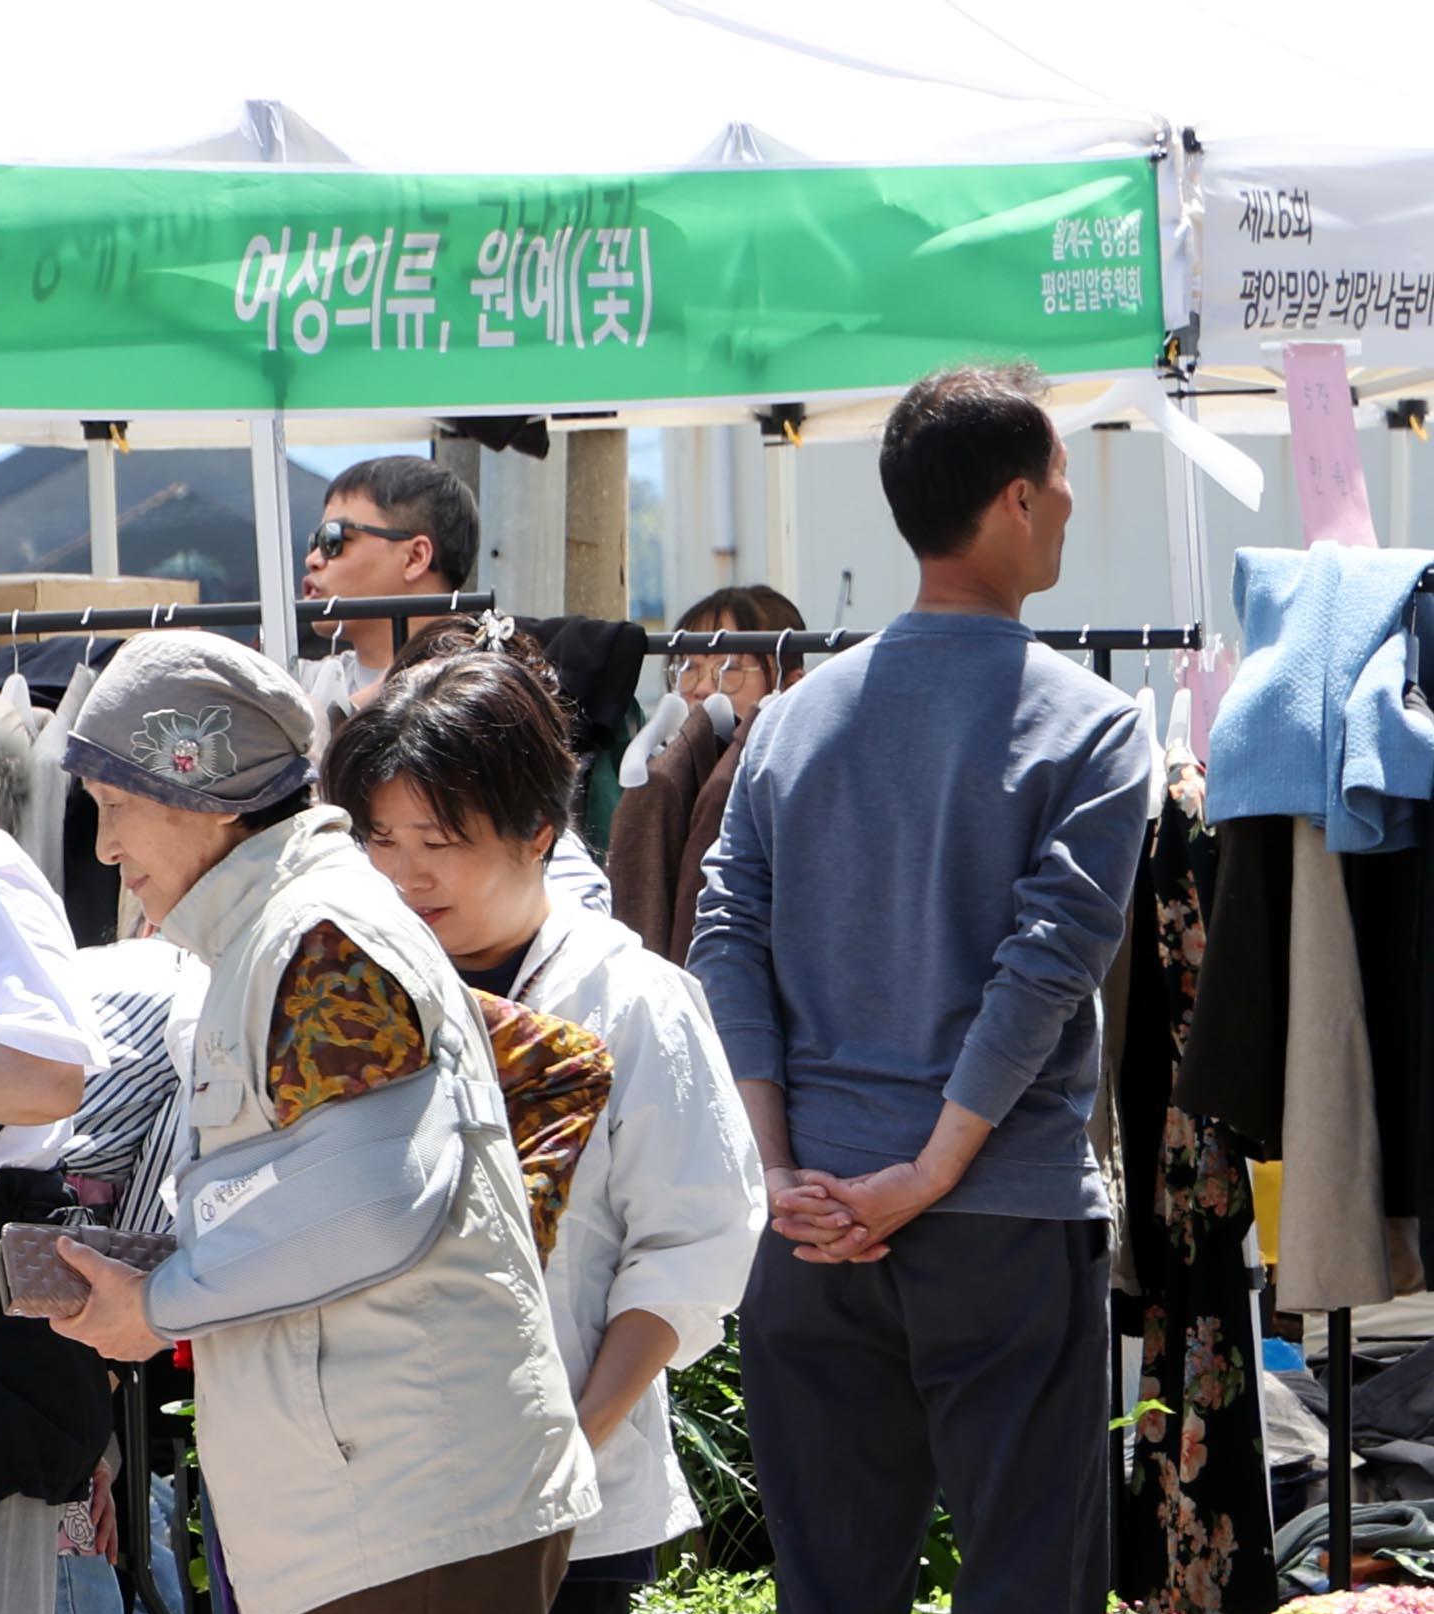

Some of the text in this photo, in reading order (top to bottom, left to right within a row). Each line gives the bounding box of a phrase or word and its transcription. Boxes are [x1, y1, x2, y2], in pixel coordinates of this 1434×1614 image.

[1238, 186, 1313, 246] 제16회
[232, 225, 449, 354] 여성의류,
[469, 225, 654, 349] 원예(꽃)
[1238, 268, 1330, 331] 평안밀알
